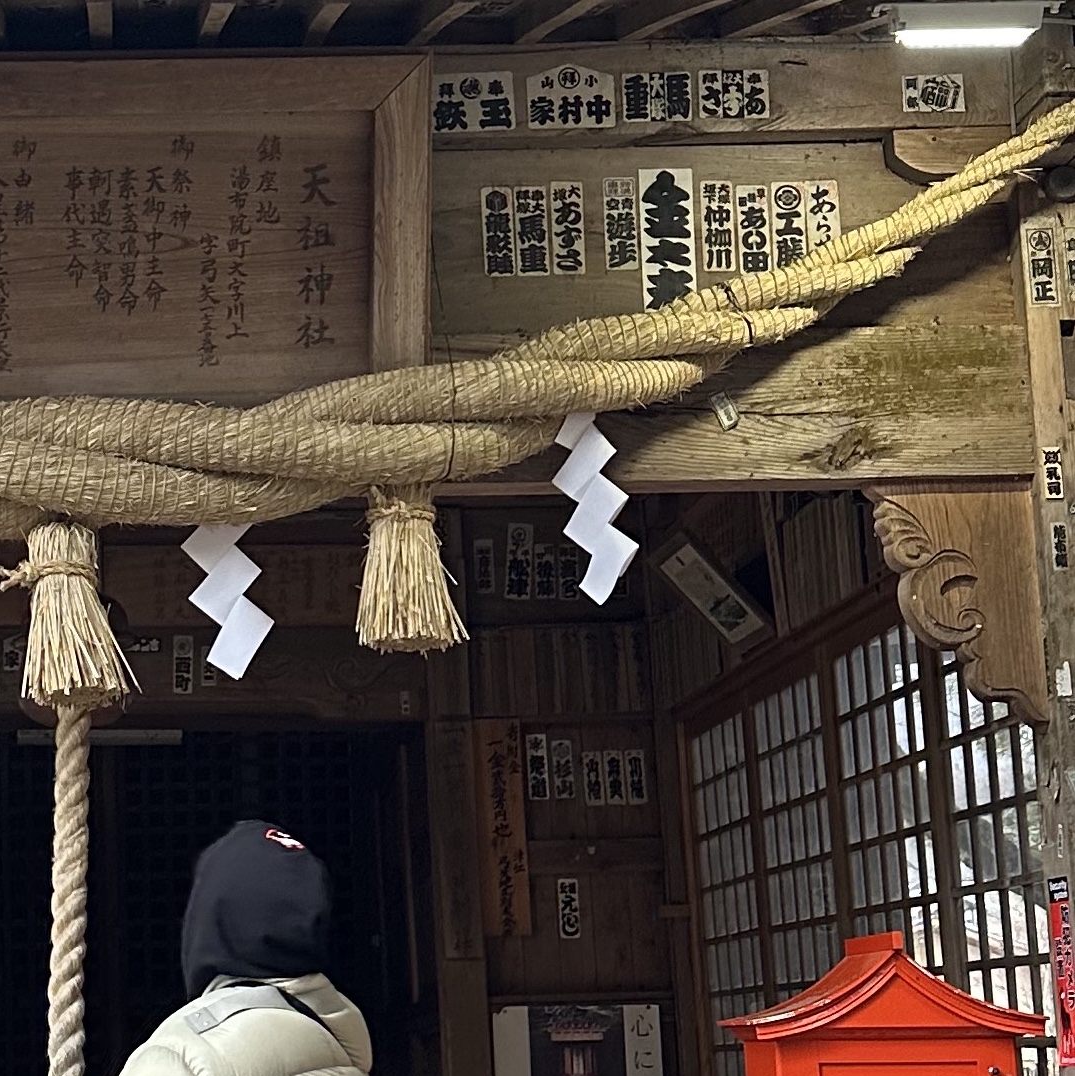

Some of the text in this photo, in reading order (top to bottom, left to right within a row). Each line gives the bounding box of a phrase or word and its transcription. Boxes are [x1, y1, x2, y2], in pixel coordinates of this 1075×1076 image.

[530, 94, 612, 125] 中村家
[13, 136, 38, 226] 御由緒
[170, 134, 194, 232] 御祭神
[256, 135, 282, 224] 鎮座地
[62, 165, 87, 289] 事代主命
[144, 165, 168, 313] 天御中主命
[226, 164, 251, 340] 湯布院町大字川上
[295, 163, 339, 350] 天祖神社
[553, 201, 583, 271] あずさ
[606, 212, 638, 268] 遊歩
